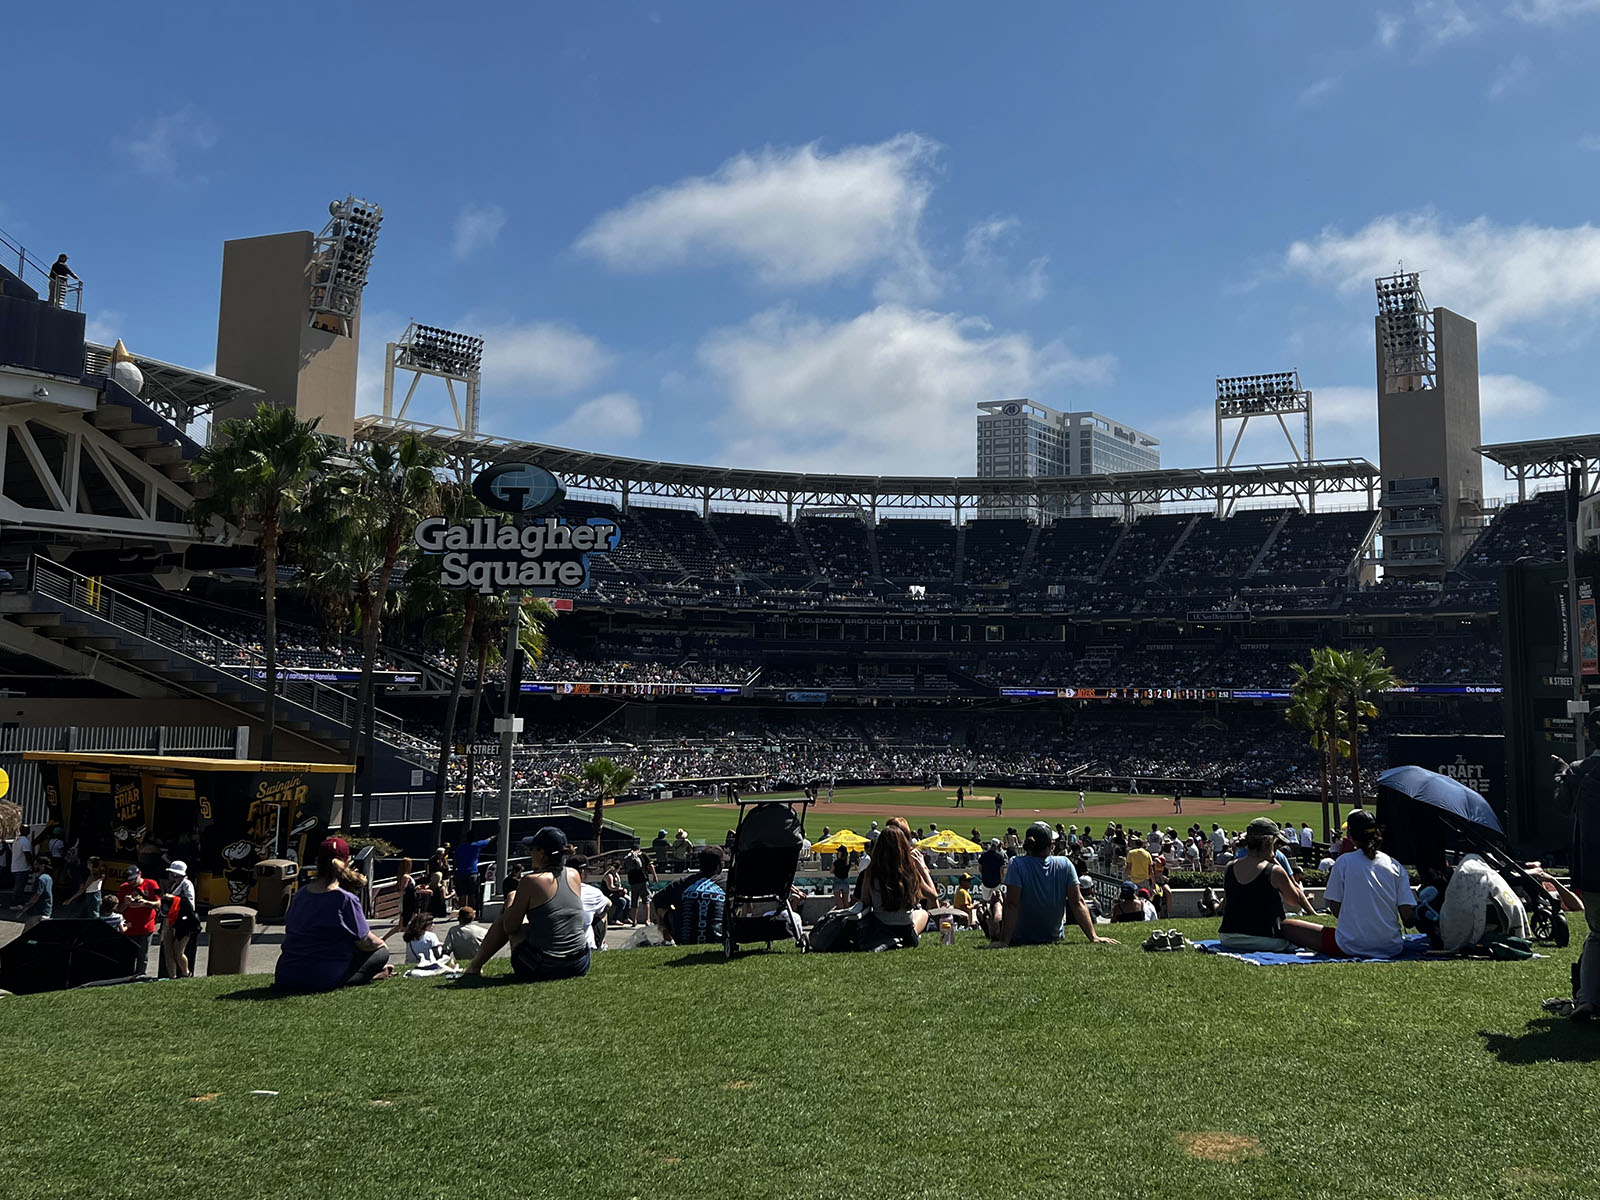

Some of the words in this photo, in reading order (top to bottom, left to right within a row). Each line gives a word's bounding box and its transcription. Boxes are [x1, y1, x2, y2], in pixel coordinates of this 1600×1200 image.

[414, 517, 615, 558] Gallagher
[440, 552, 583, 594] Square
[798, 617, 842, 625] COLEMAN
[844, 617, 902, 625] BROADCAST
[904, 617, 941, 625] CENTER
[1554, 676, 1573, 686] STREET
[1157, 688, 1162, 698] 2
[466, 744, 472, 755] K
[472, 744, 501, 755] STREET
[1438, 764, 1484, 779] CRAFT
[114, 787, 140, 810] FRIAR
[120, 803, 137, 822] ALE
